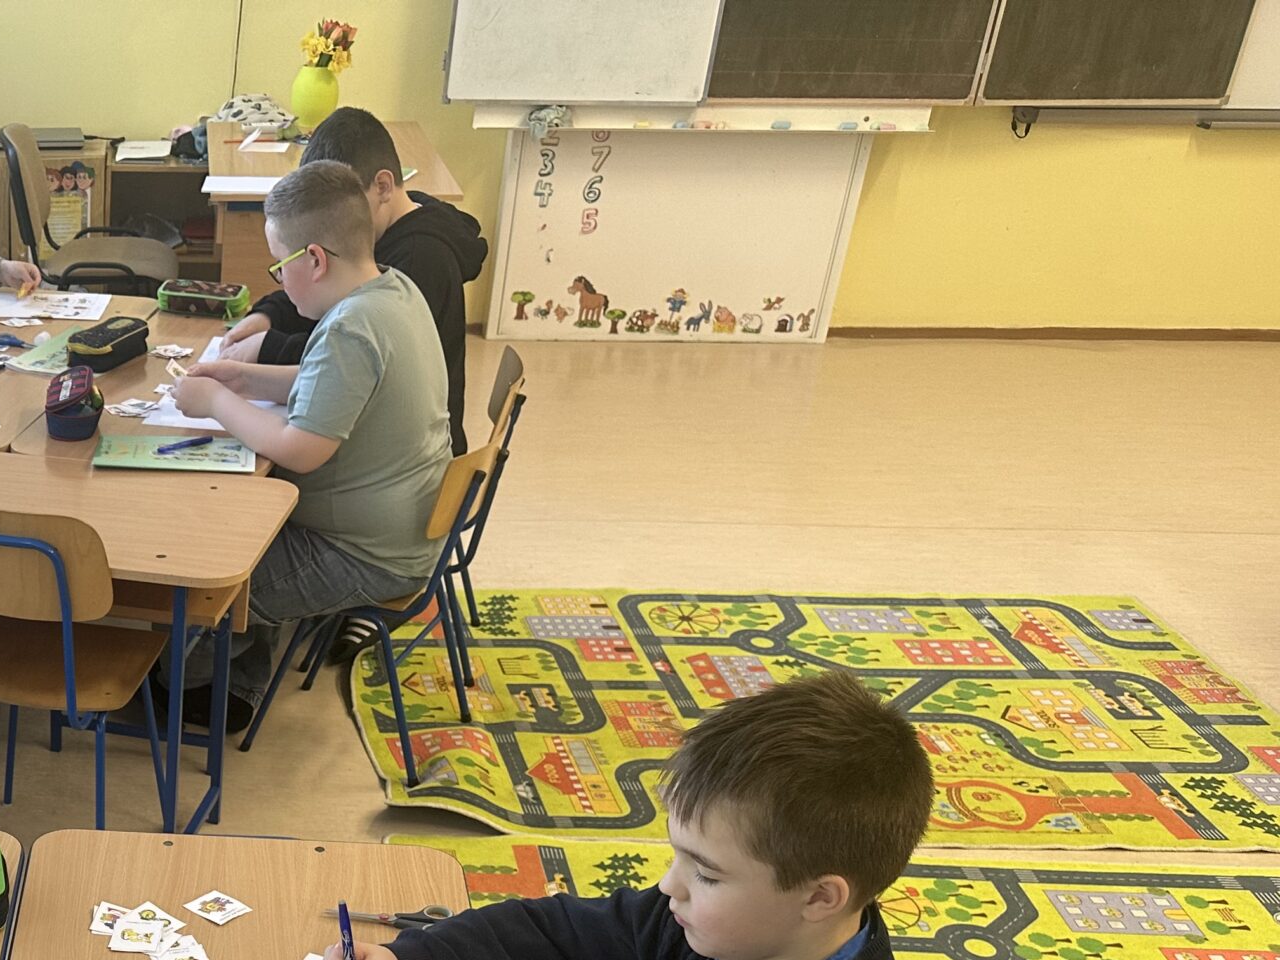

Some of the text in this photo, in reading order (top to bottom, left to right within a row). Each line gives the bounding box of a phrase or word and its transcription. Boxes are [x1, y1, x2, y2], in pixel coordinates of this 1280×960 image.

[538, 149, 556, 177] 3
[592, 145, 611, 172] 7
[533, 180, 553, 208] 4
[583, 176, 604, 203] 6
[580, 208, 599, 235] 5
